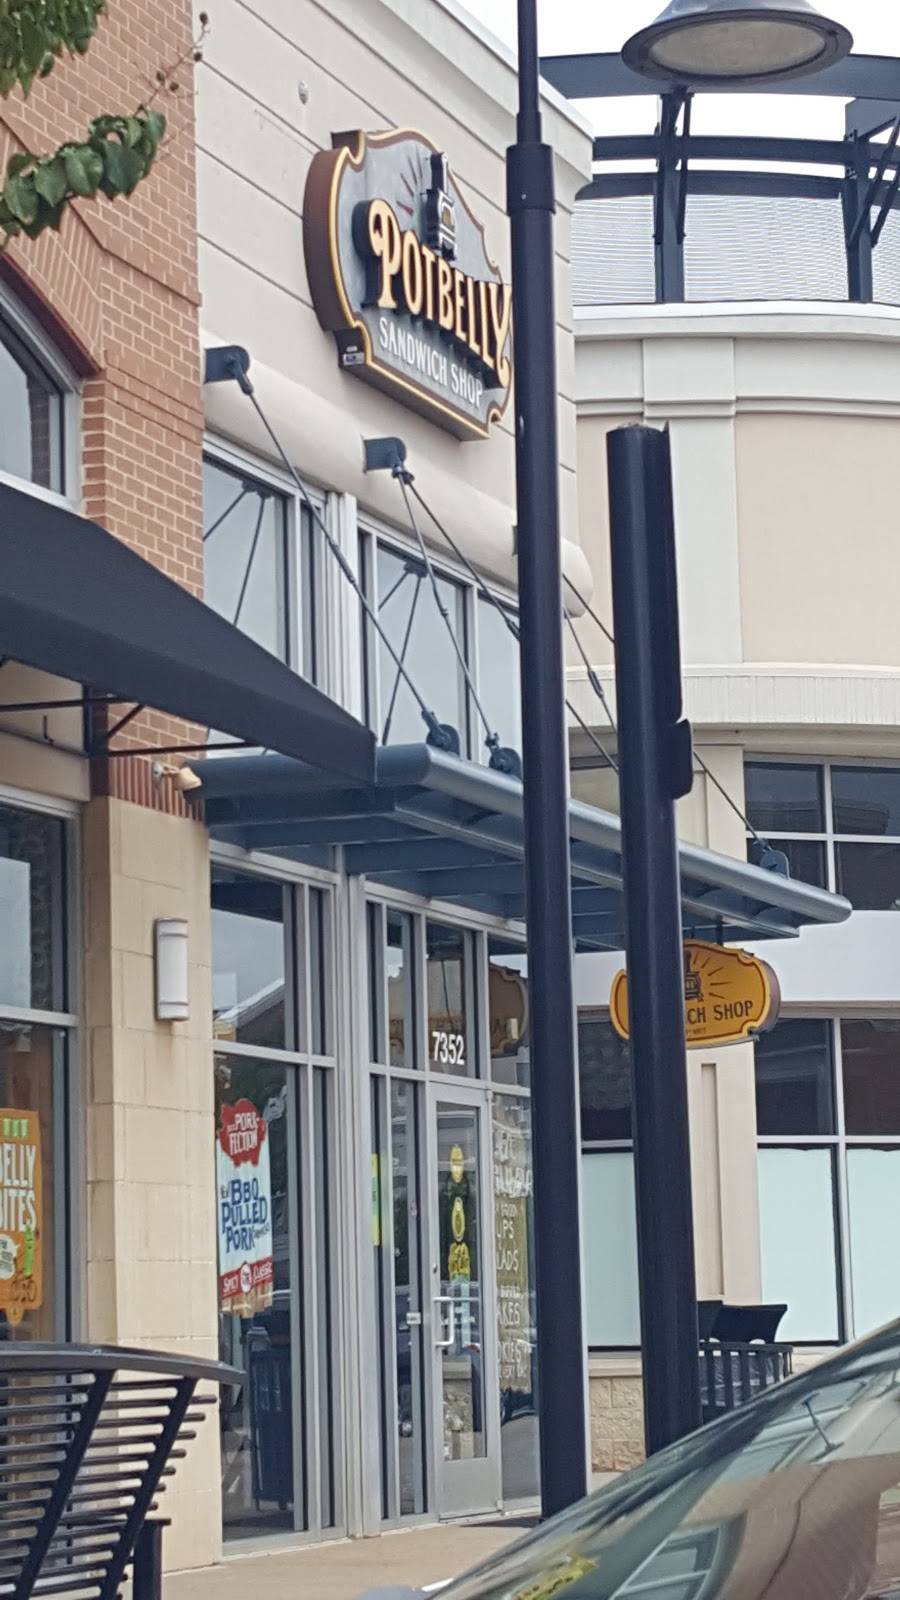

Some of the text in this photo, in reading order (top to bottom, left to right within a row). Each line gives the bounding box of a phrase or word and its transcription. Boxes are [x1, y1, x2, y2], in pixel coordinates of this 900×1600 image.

[368, 198, 511, 389] POTBELLY
[379, 316, 483, 409] SANDWICH SHOP
[713, 1000, 754, 1021] SHOP
[431, 1030, 465, 1066] 7352
[230, 1177, 260, 1206] BBQ
[220, 1195, 268, 1235] PULLED
[225, 1225, 256, 1254] PORK
